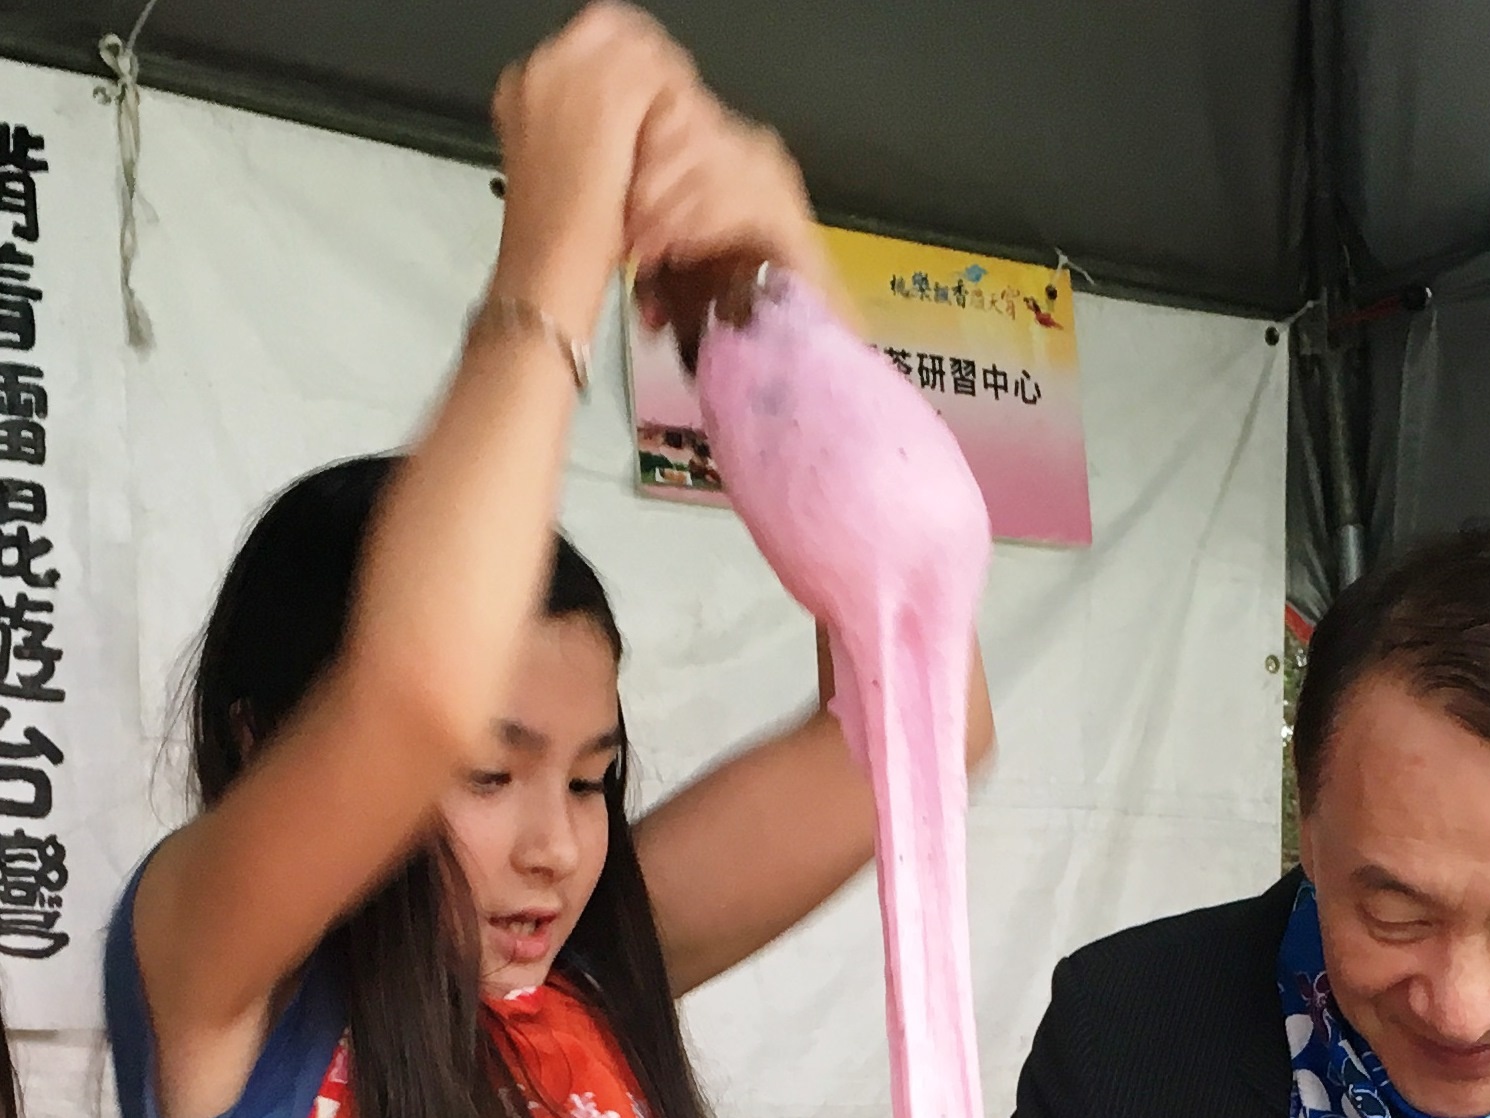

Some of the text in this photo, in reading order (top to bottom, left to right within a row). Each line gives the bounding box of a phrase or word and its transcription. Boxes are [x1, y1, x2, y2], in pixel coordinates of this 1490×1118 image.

[868, 343, 1042, 405] 茶研習中心
